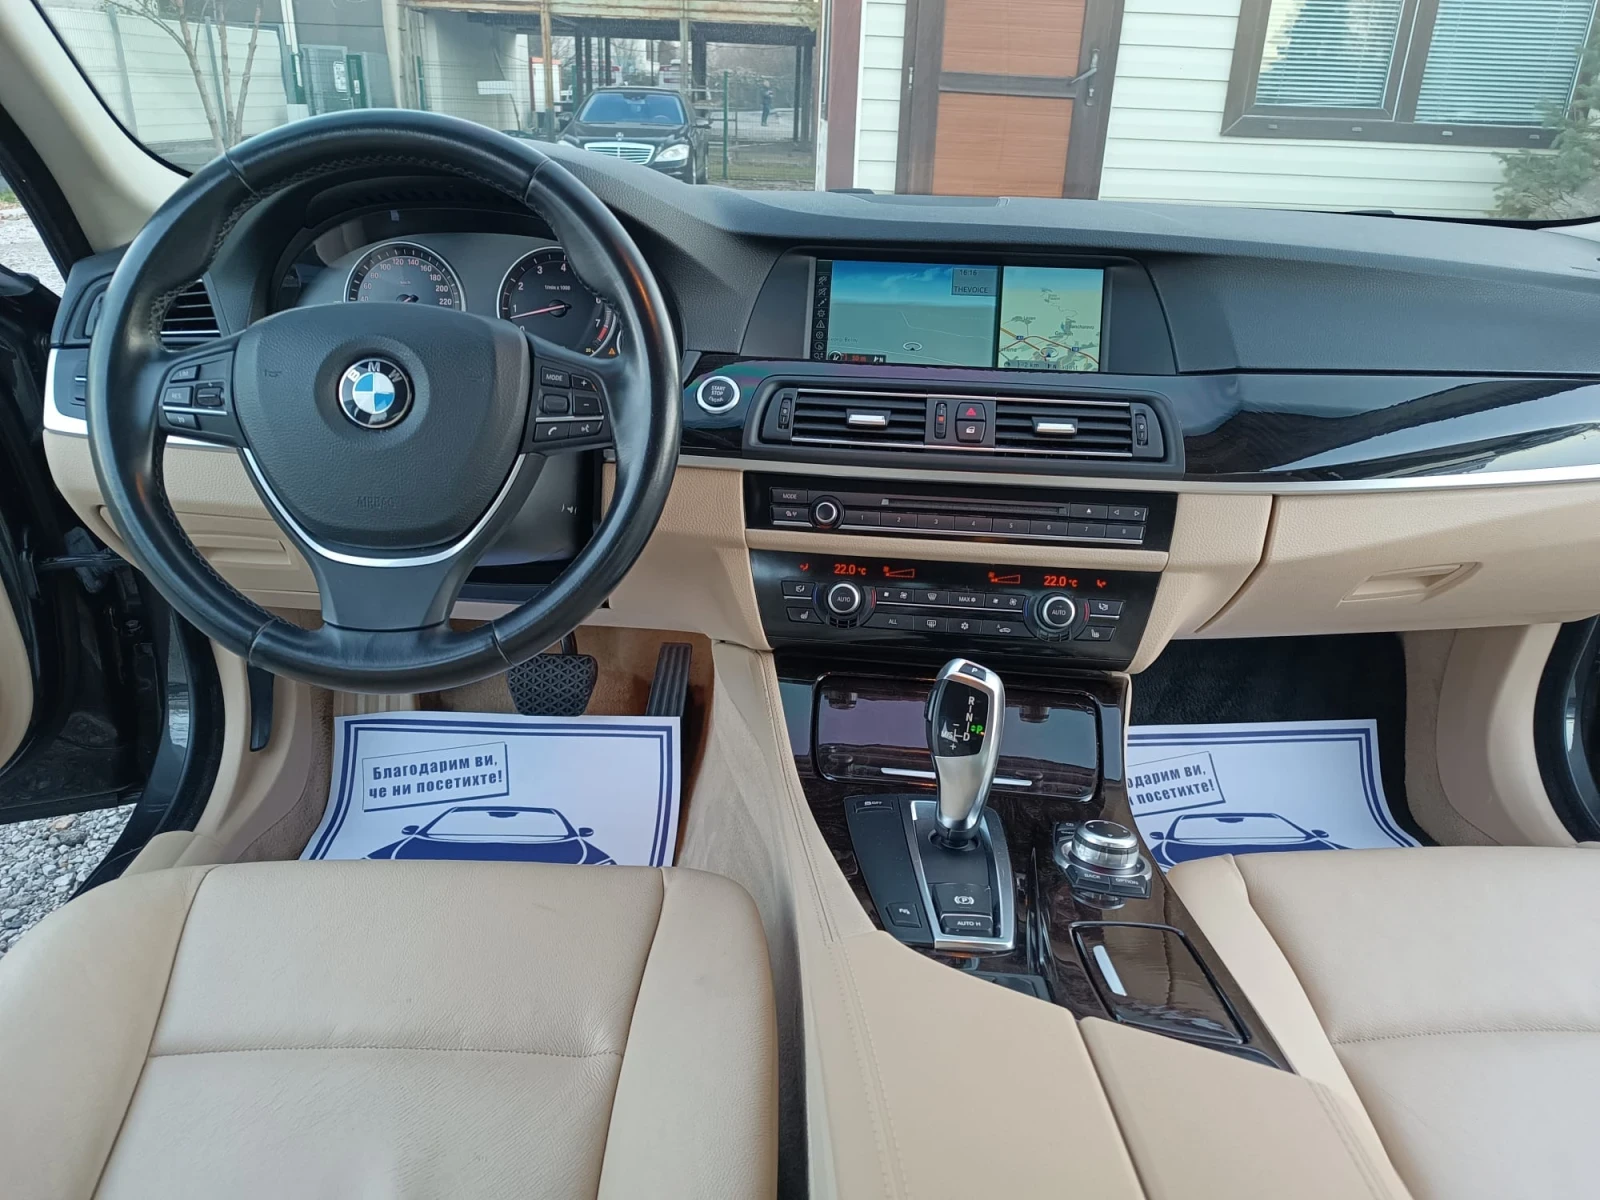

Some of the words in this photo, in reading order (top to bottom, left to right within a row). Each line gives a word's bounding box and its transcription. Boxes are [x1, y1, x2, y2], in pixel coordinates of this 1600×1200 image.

[408, 258, 419, 266] 140
[536, 265, 543, 275] 3
[560, 263, 567, 272] 4
[435, 285, 449, 293] 200
[518, 282, 524, 291] 2
[953, 286, 989, 294] THEVOICE
[439, 298, 452, 306] 220
[512, 304, 518, 313] 1
[595, 319, 601, 328] 7
[347, 361, 403, 383] BMW
[545, 373, 563, 381] MODE
[834, 563, 856, 575] 22.0
[1043, 575, 1066, 587] 22.0
[968, 696, 975, 705] R
[965, 713, 973, 722] N
[963, 732, 970, 741] D
[372, 758, 470, 781] Благодарим
[474, 754, 498, 767] ви,
[1183, 764, 1206, 778] ви,
[368, 786, 387, 799] че
[392, 783, 411, 796] ни
[416, 769, 503, 793] посетихте!
[1136, 778, 1215, 805] посетихте!
